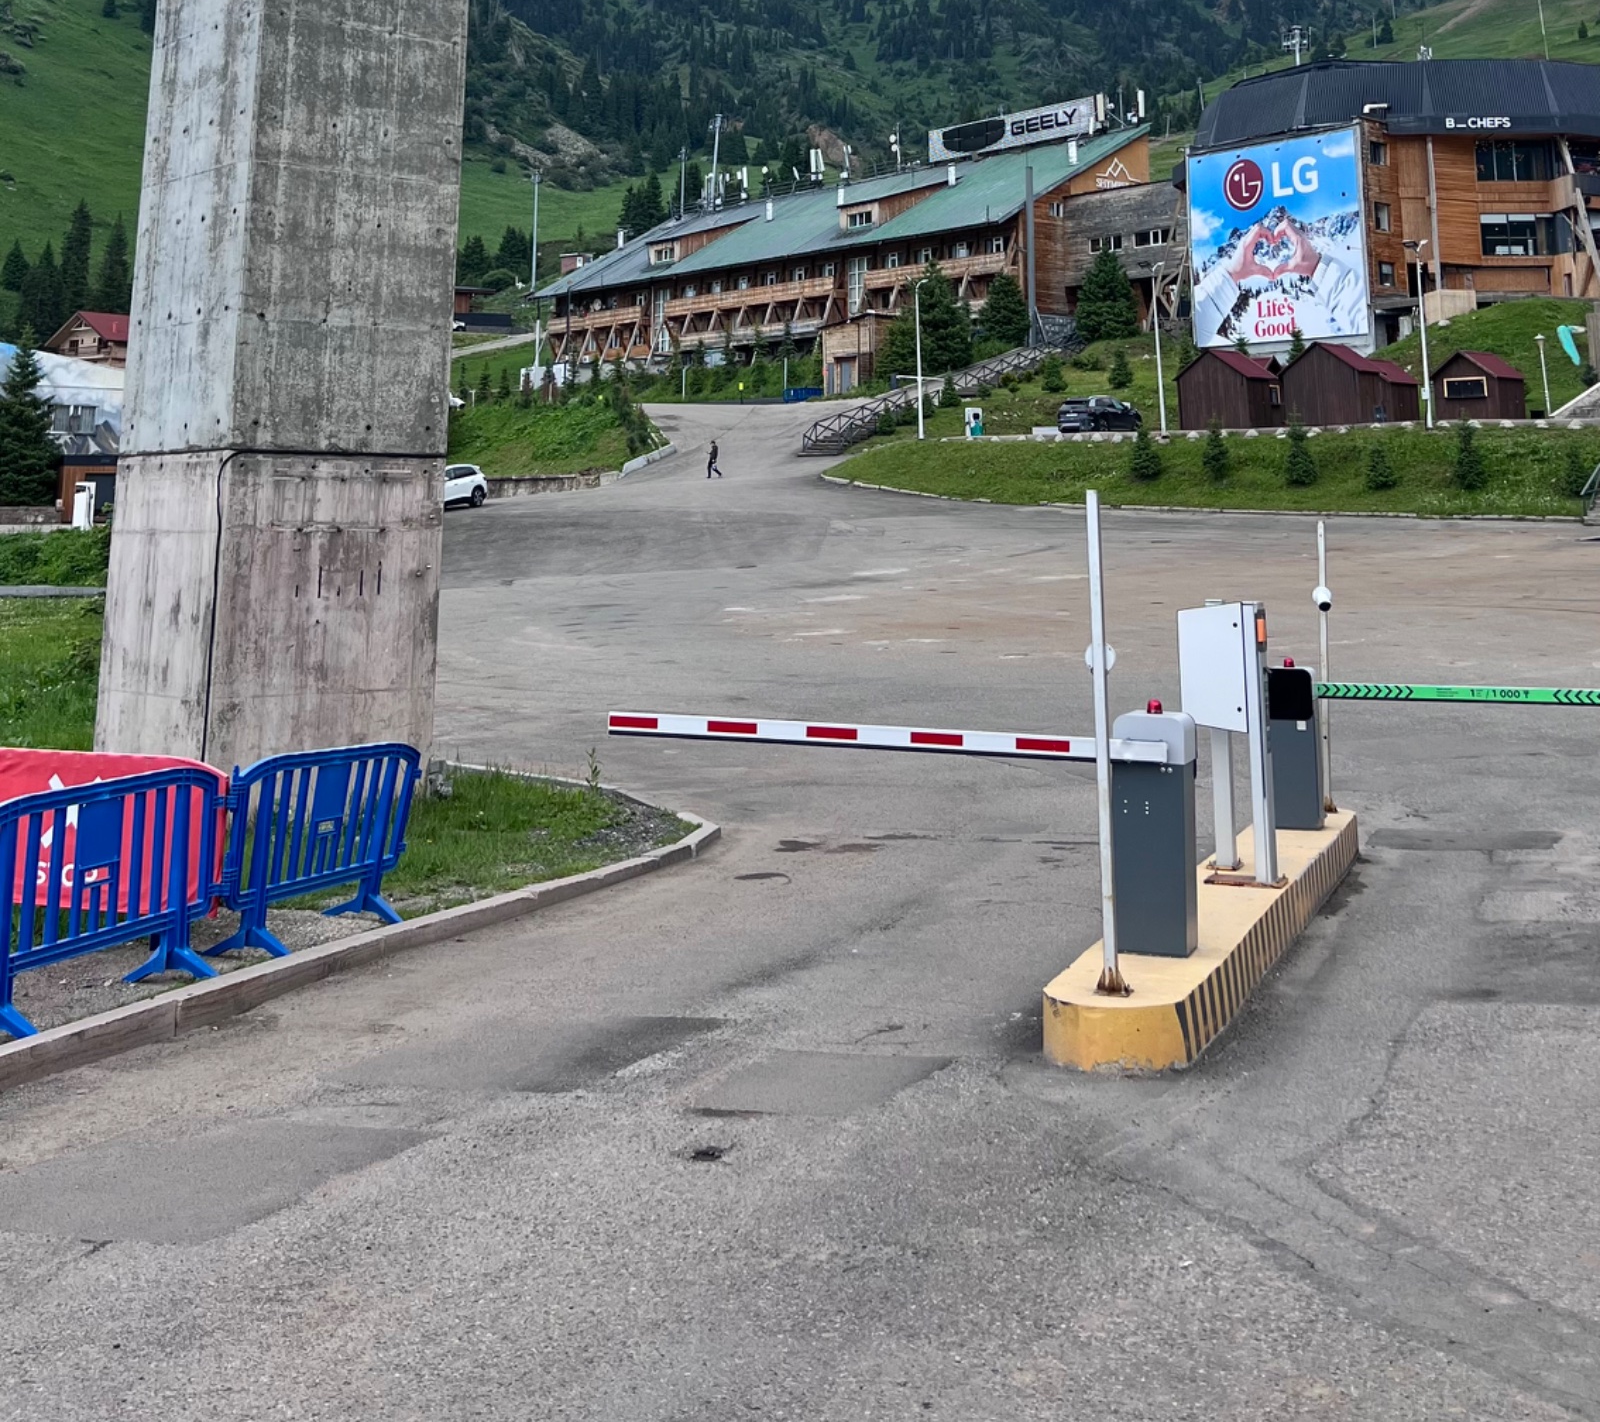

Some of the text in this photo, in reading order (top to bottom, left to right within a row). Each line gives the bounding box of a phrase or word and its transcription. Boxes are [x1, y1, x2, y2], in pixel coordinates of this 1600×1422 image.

[1011, 108, 1077, 136] GEELY
[1271, 156, 1319, 198] LG
[1257, 297, 1295, 318] Life's
[1254, 317, 1297, 338] Good
[37, 861, 98, 887] SO
